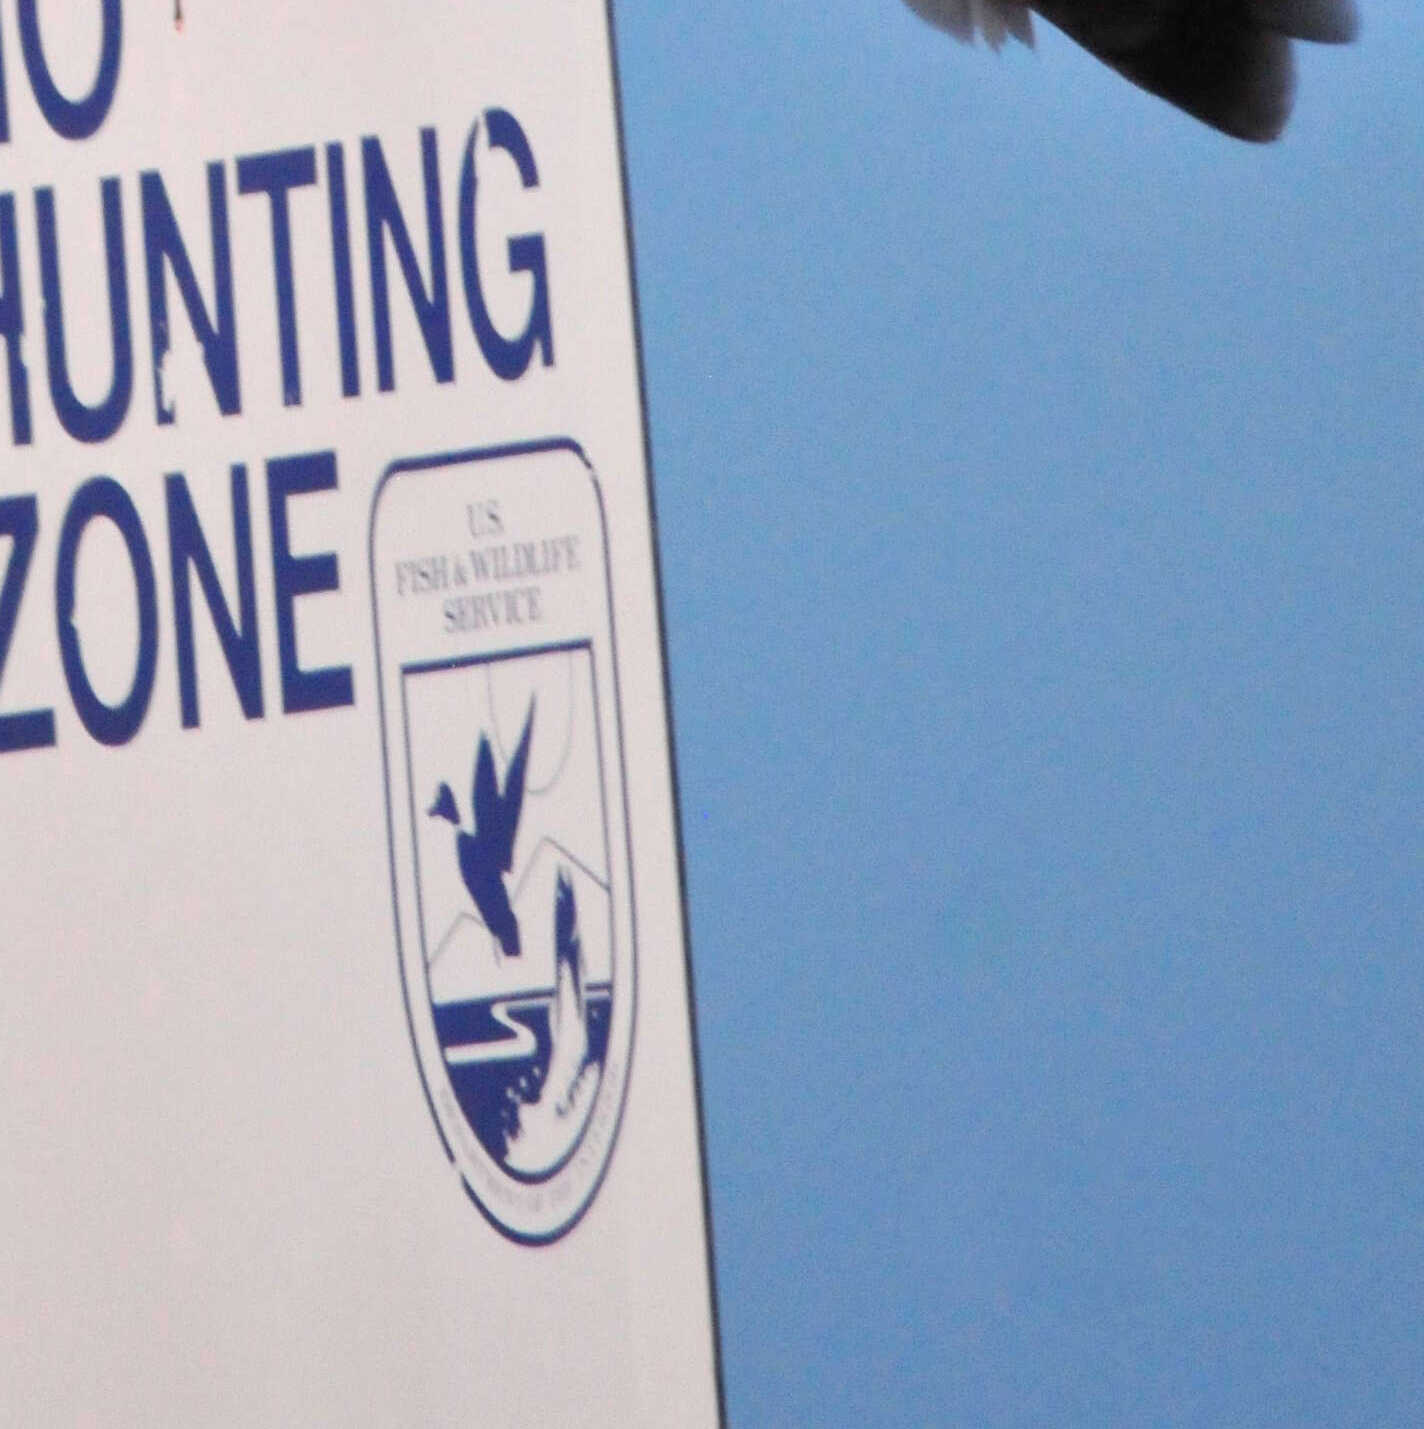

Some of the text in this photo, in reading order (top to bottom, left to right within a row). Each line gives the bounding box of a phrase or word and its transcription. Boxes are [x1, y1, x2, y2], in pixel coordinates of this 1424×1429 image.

[394, 555, 449, 596] FISH
[469, 535, 580, 582] WILDLIFE
[442, 586, 543, 633] SERVICE
